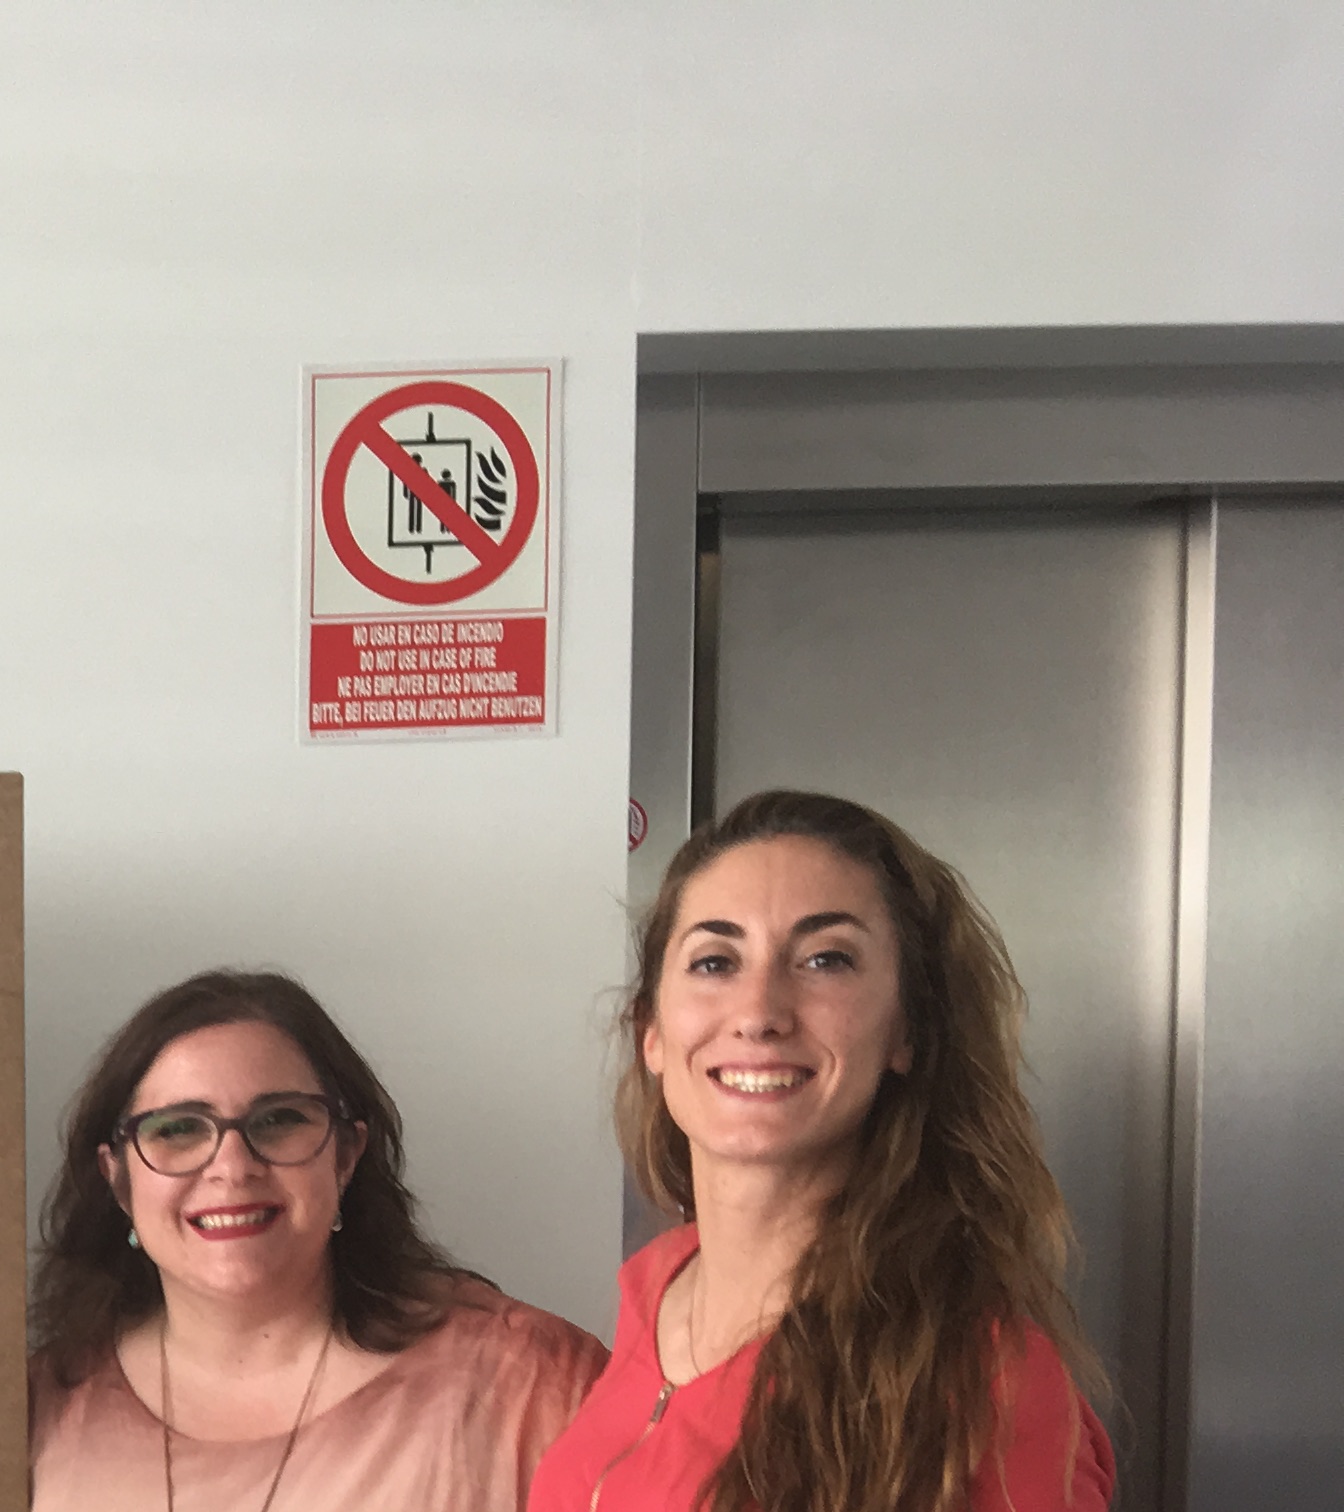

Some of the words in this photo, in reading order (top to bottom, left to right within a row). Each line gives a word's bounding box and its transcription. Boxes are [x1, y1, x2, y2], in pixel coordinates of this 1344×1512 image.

[353, 626, 367, 646] NO
[370, 625, 396, 646] USAR
[398, 624, 411, 644] EN
[413, 624, 439, 644] CASO
[441, 623, 454, 643] DE
[457, 621, 503, 643] INCENDIO
[361, 650, 373, 671] DO
[377, 650, 395, 671] NOT
[399, 649, 417, 670] USE
[420, 650, 429, 670] IN
[433, 648, 457, 669] CASE
[460, 647, 472, 668] OF
[475, 647, 496, 668] FIRE
[338, 677, 351, 697] NE
[354, 675, 372, 697] PAS
[374, 675, 424, 696] EMPLOYER
[427, 674, 440, 694] EN
[442, 673, 461, 694] CAS
[345, 701, 361, 722] BEI
[363, 700, 395, 722] FEUER
[397, 700, 417, 721] DEN
[418, 698, 457, 720] AUFZUG
[459, 697, 489, 718] NICHT
[491, 696, 542, 717] BENUTZEN
